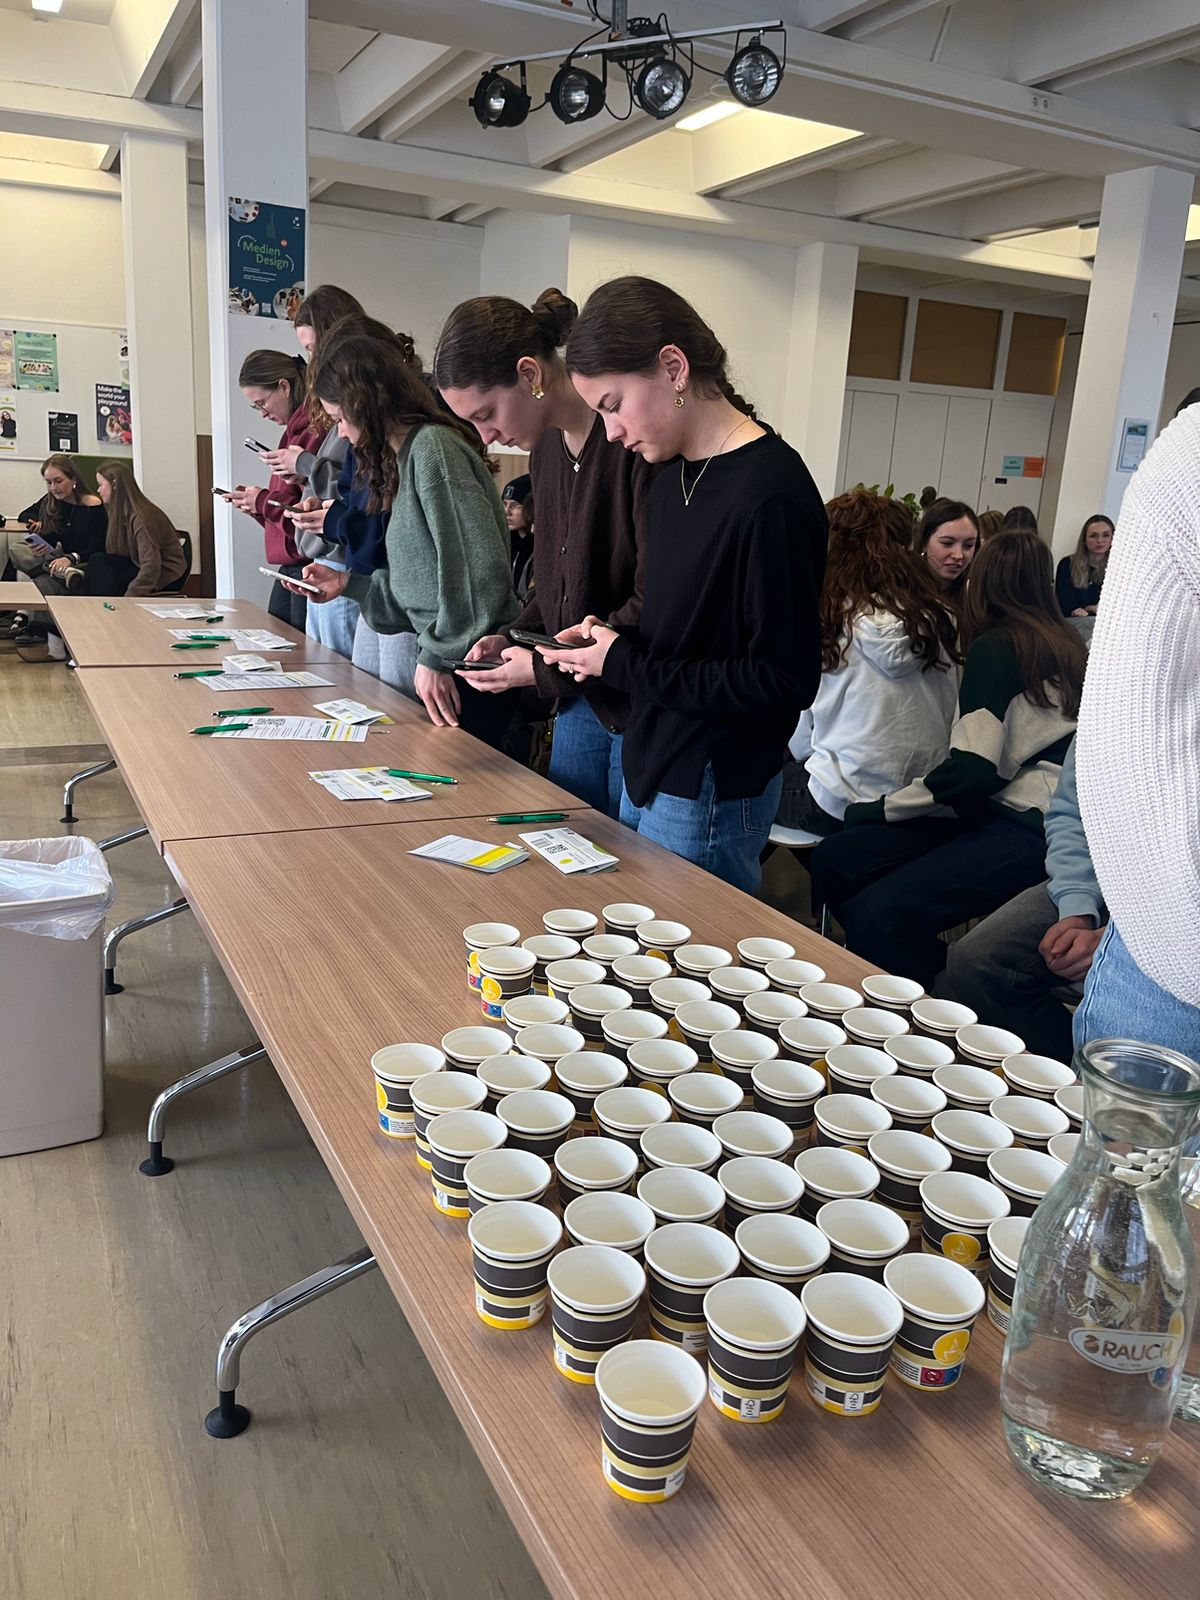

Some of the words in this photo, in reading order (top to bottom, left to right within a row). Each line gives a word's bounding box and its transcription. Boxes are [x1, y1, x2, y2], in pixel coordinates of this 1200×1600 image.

[243, 241, 281, 256] Medien
[256, 254, 289, 270] Design
[97, 385, 113, 393] Make
[97, 392, 113, 400] world
[97, 399, 128, 408] playground
